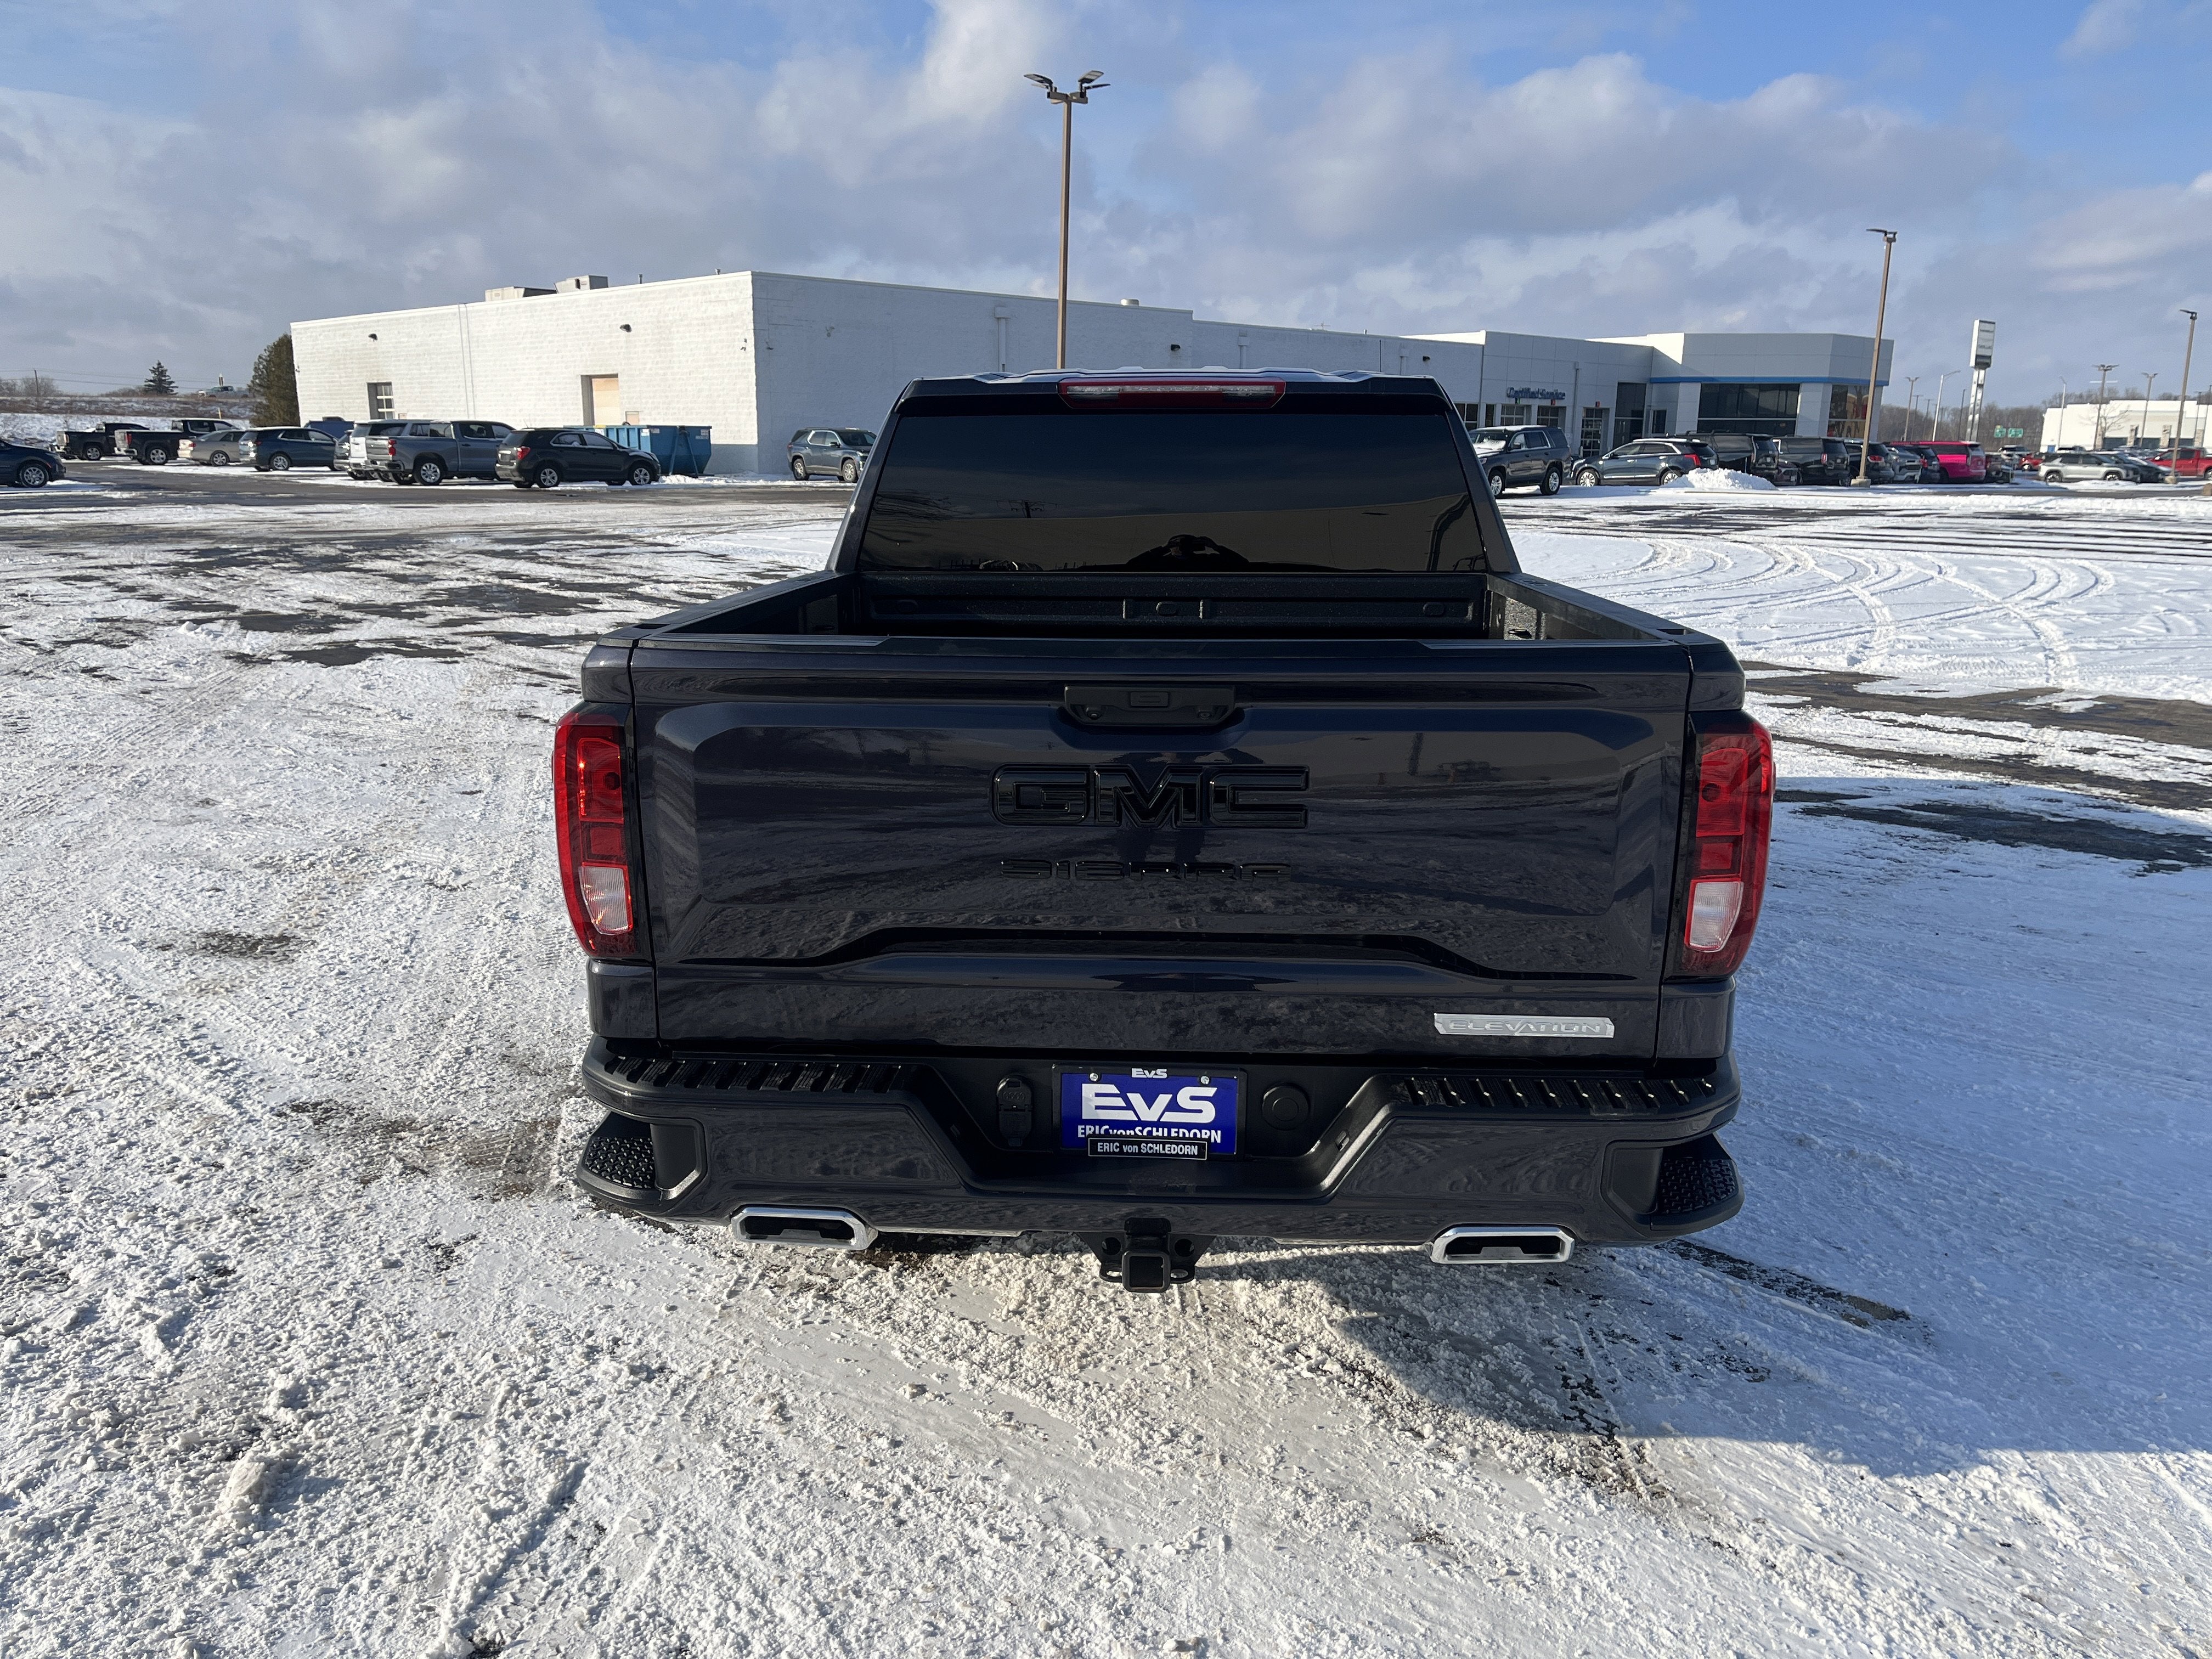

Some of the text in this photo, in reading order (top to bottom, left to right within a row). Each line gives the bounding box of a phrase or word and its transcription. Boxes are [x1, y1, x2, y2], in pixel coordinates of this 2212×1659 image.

[992, 764, 1310, 829] GMC
[1448, 1018, 1601, 1034] ELEVATION
[1097, 1143, 1120, 1153] ERIC
[1141, 1143, 1198, 1155] SCHLEDORN
